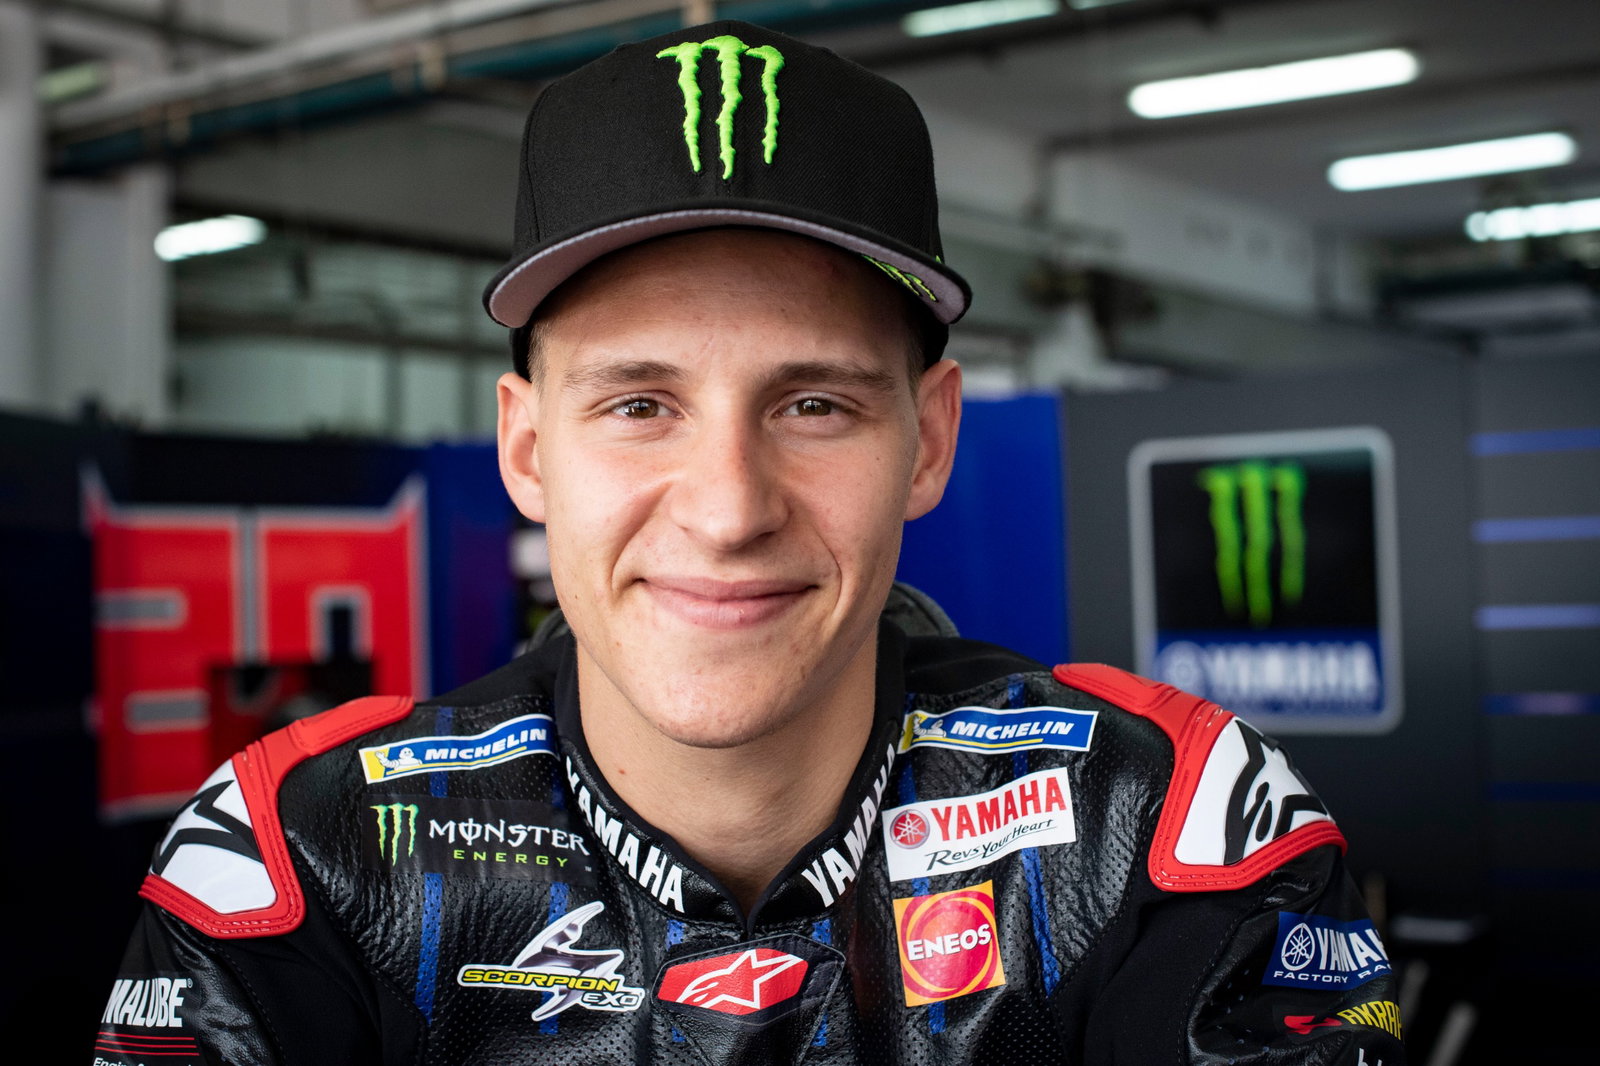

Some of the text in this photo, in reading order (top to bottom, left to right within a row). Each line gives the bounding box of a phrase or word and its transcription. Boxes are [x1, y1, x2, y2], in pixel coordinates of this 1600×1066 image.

[425, 729, 547, 761] MICHELIN
[950, 720, 1075, 740] MICHELIN
[801, 743, 895, 907] YAMAHA
[931, 777, 1067, 842] YAMAHA
[428, 818, 590, 856] MONSTER
[566, 756, 686, 914] YAMAHA
[925, 819, 1054, 871] Revs Your Heart
[453, 849, 569, 867] ENERGY
[906, 923, 992, 961] ENEOS
[462, 969, 621, 992] SCORPION
[1273, 964, 1392, 984] FACTORY RA
